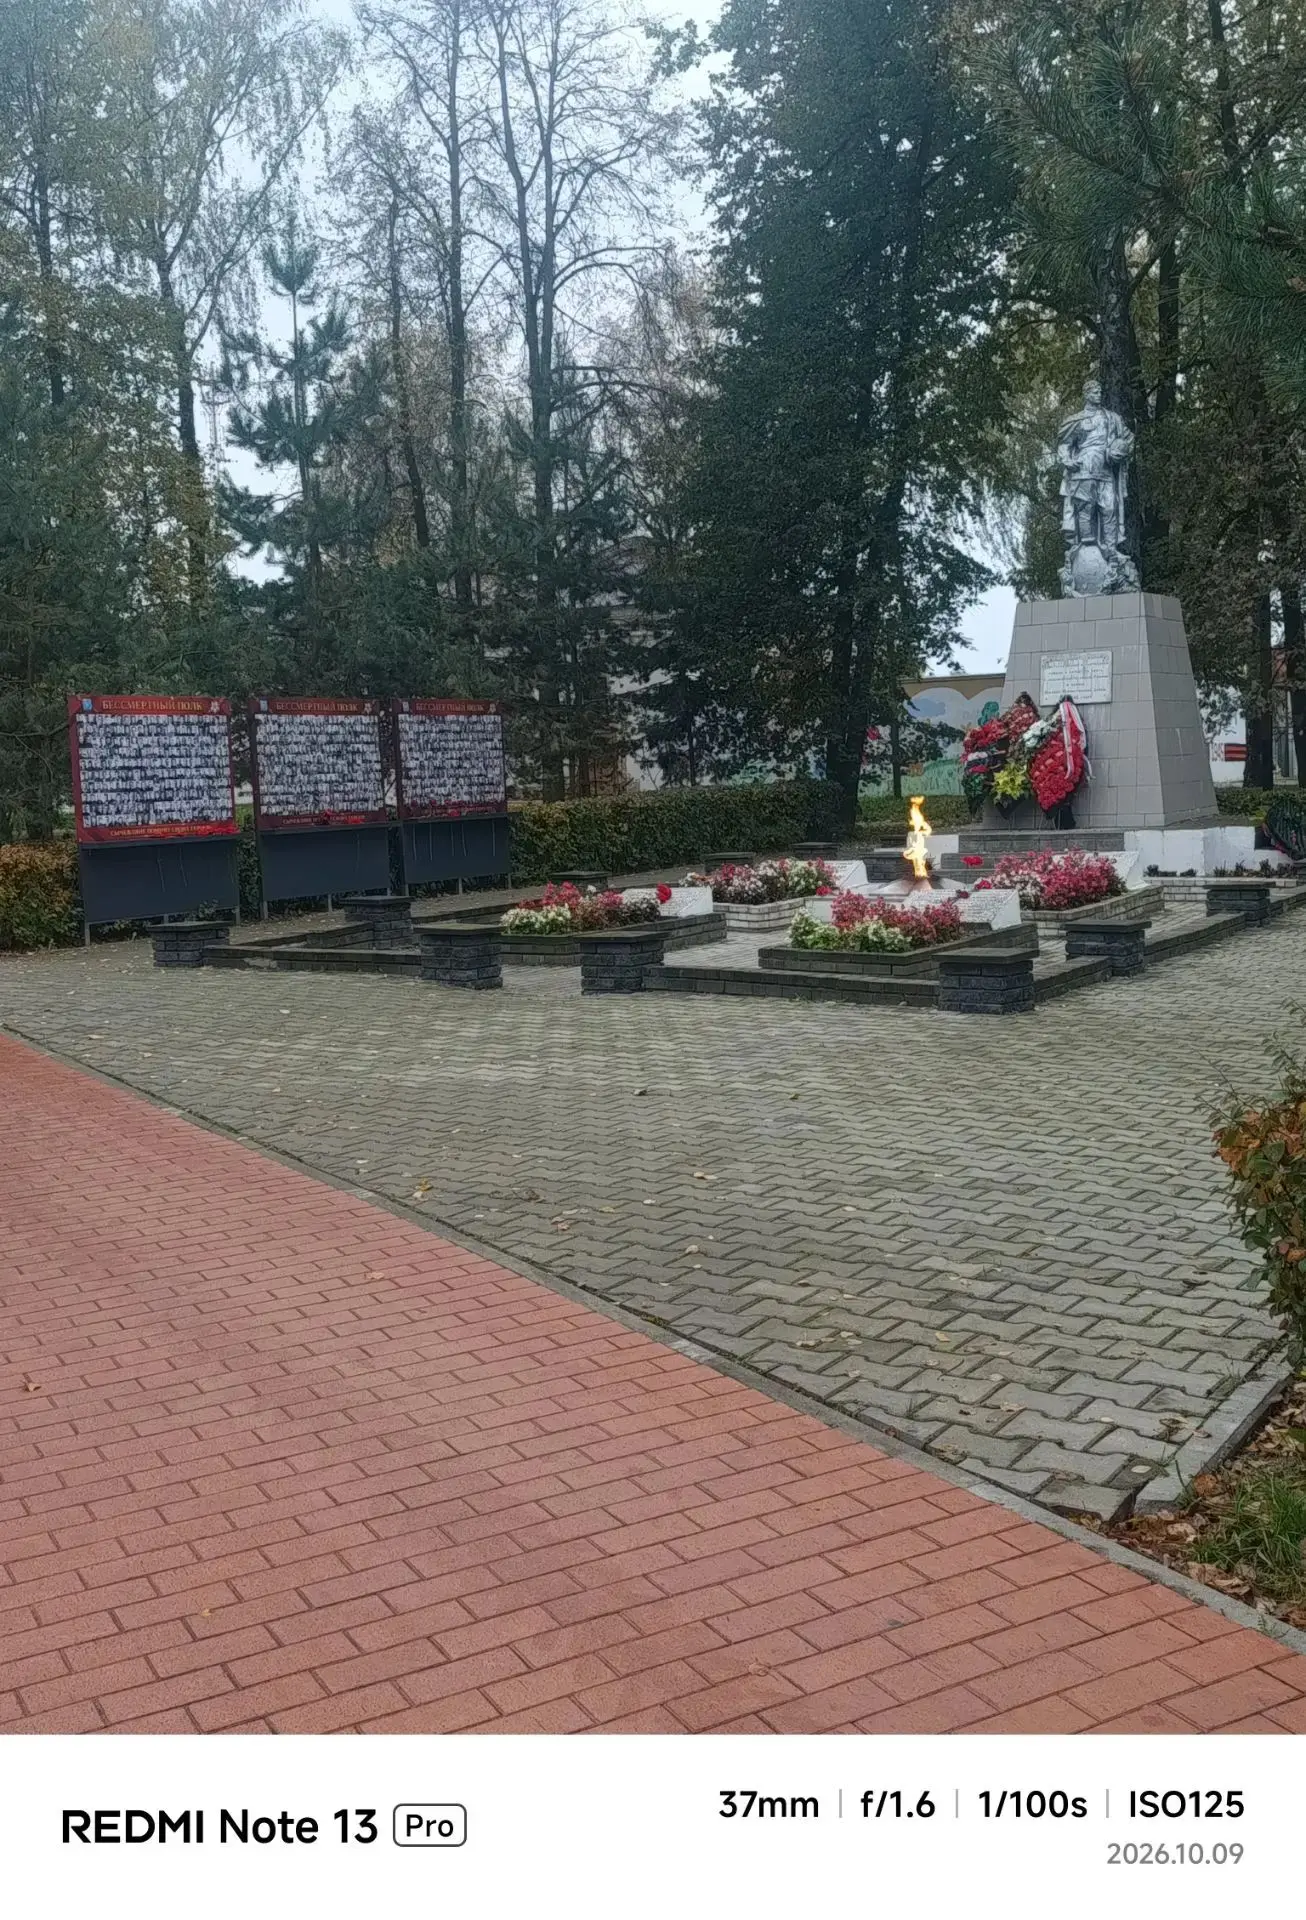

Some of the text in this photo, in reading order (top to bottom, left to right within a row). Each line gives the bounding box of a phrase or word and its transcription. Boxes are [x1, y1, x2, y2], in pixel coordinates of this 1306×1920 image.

[102, 700, 202, 711] БЕССМЕРТНЫЙ ПОЛК
[276, 701, 358, 711] БЕССМЕРТНЫЙ ПОЛК
[416, 702, 465, 712] БЕССМЕРТНЫЙ
